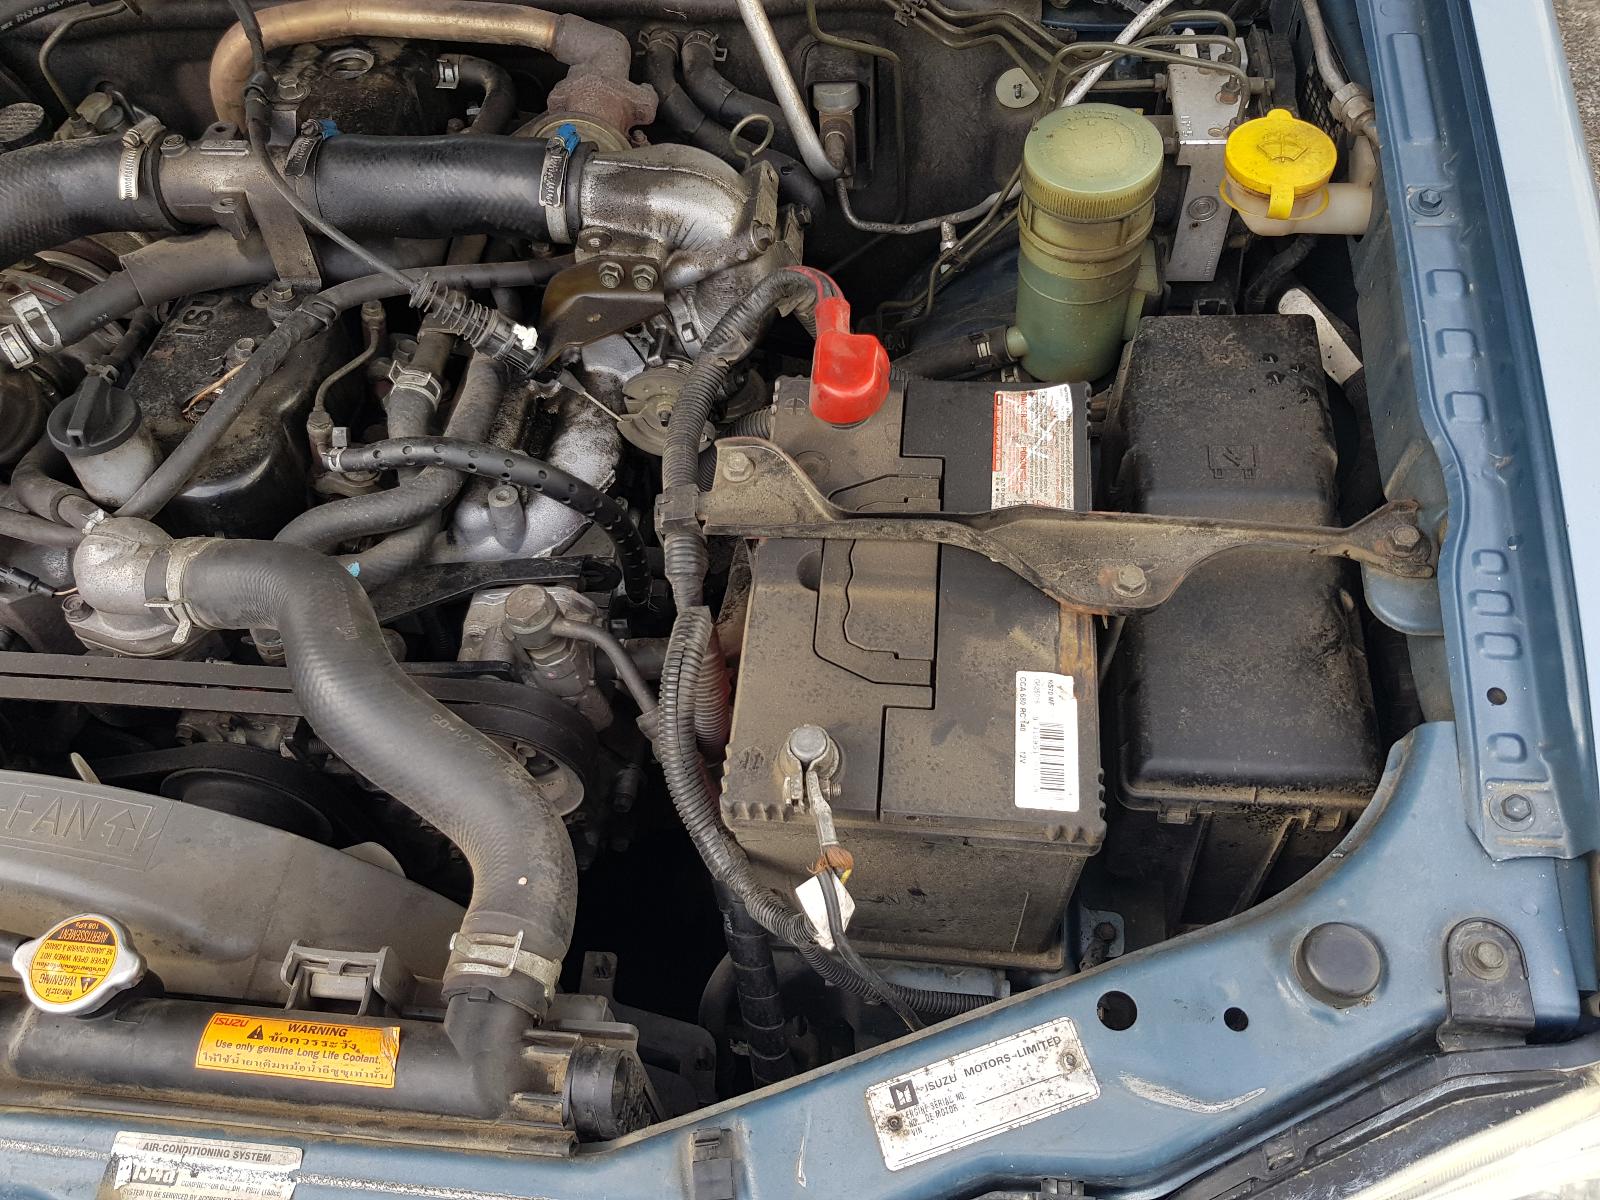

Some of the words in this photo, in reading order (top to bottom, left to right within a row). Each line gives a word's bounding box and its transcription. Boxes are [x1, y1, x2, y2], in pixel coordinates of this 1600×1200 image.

[1019, 676, 1027, 691] CCA
[57, 928, 110, 943] AVERTISSEMENT
[53, 952, 72, 962] WHEN
[72, 955, 89, 963] OPEN
[90, 956, 110, 966] NEVER
[38, 973, 78, 987] WARNING
[213, 1016, 250, 1028] ISUZU
[287, 1023, 348, 1037] WARNING
[215, 1039, 233, 1049] Use
[235, 1042, 255, 1053] only
[257, 1044, 293, 1056] genuine
[296, 1047, 320, 1059] Long
[322, 1050, 339, 1060] Life
[342, 1052, 381, 1064] Coolant.
[924, 1073, 957, 1092] ISUZU
[963, 1053, 1011, 1077] MOTORS
[1017, 1036, 1061, 1058] LIMITED
[142, 1142, 230, 1158] AIR-CONDITIONING
[232, 1150, 272, 1163] SYSTEM
[123, 1188, 145, 1197] SYSTEM
[145, 1190, 153, 1198] TO
[161, 1191, 189, 1200] SERVICED
